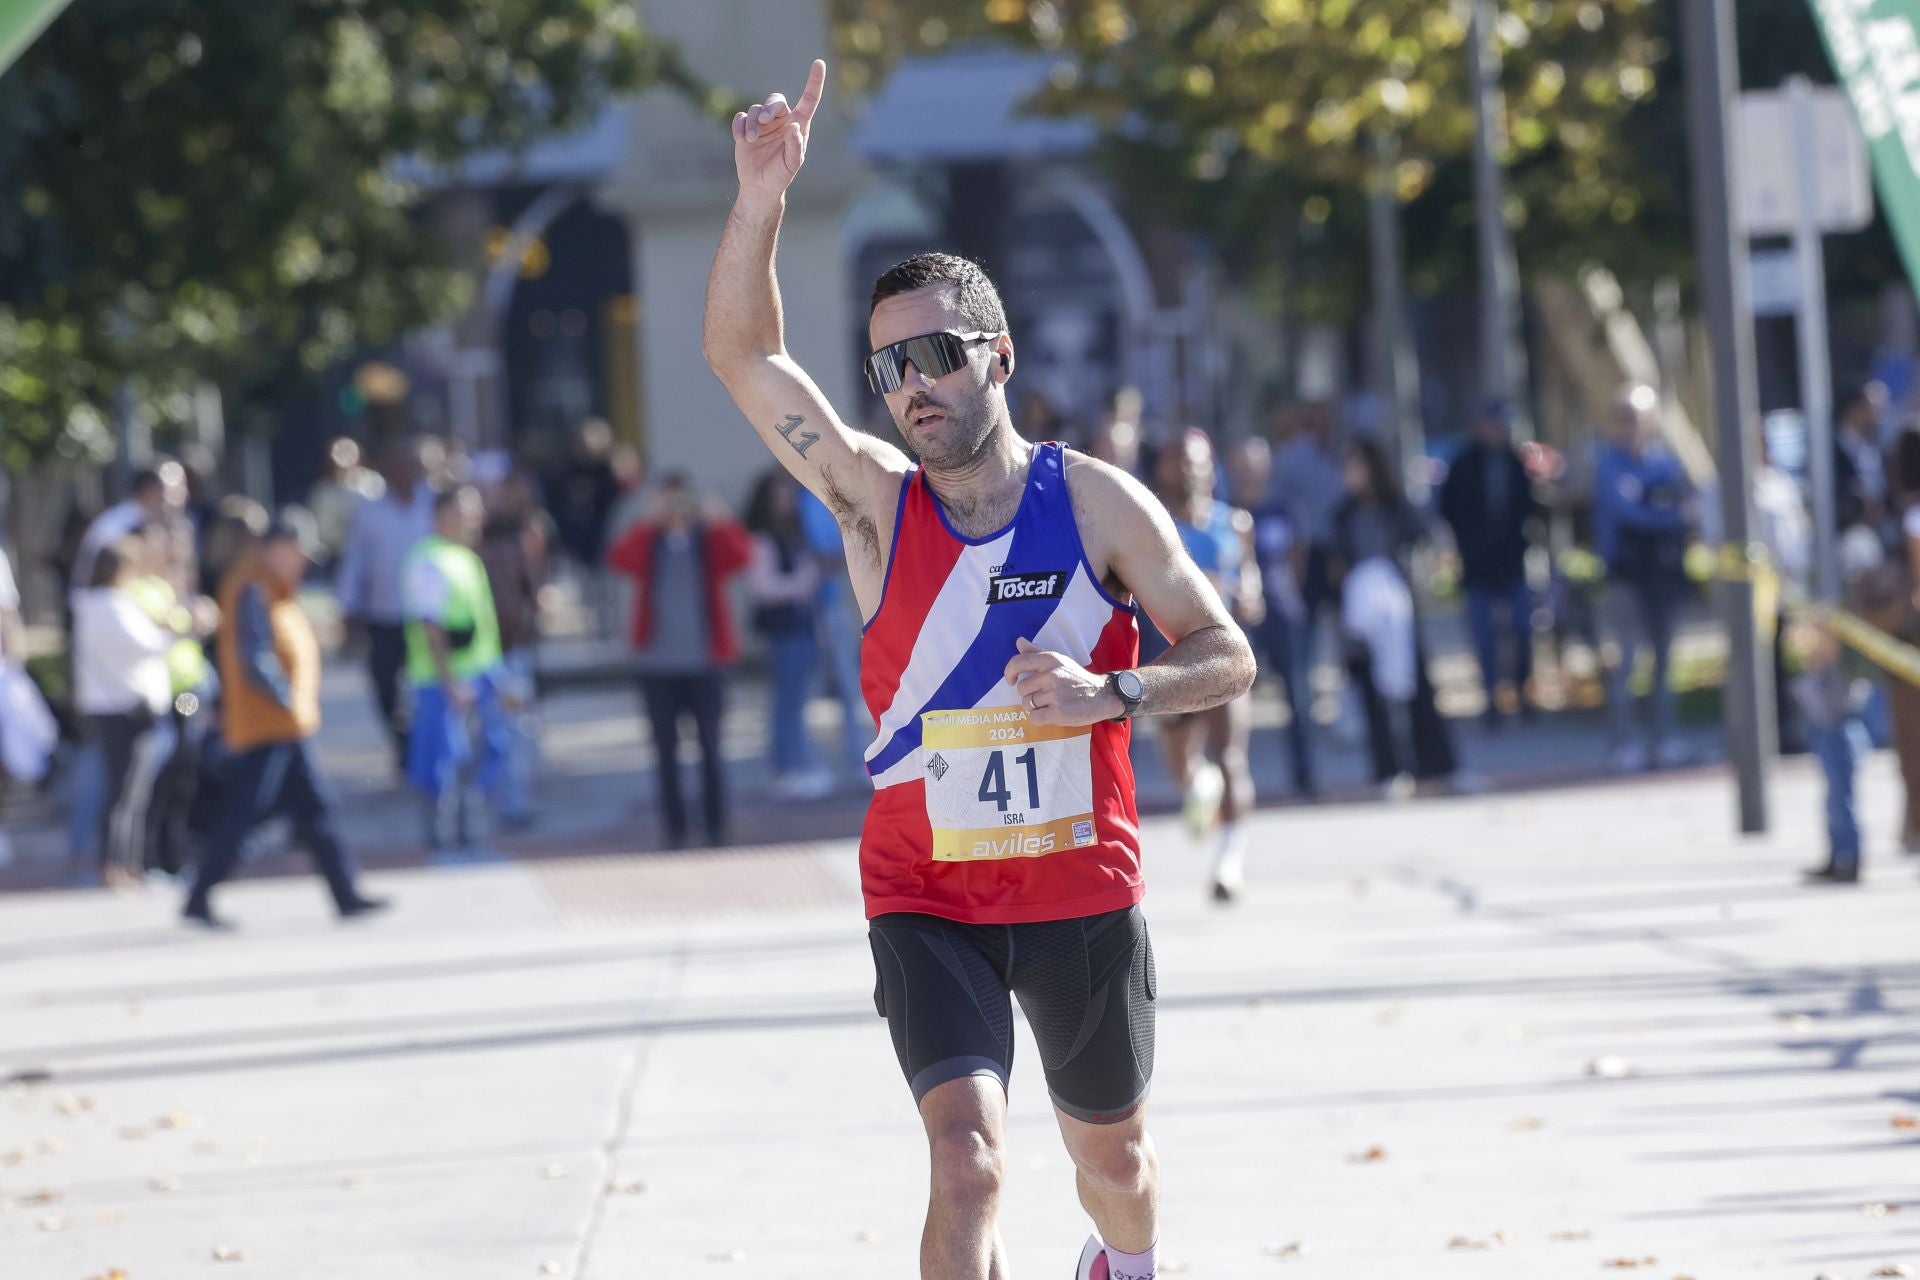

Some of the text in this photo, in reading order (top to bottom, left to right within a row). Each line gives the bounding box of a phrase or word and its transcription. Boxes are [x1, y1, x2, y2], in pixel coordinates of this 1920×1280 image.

[993, 574, 1058, 601] Toscaf
[958, 713, 991, 725] MEDIA
[988, 726, 1025, 741] 2024
[978, 747, 1040, 812] 41
[1003, 812, 1025, 826] ISRA
[972, 832, 1056, 857] avilés
